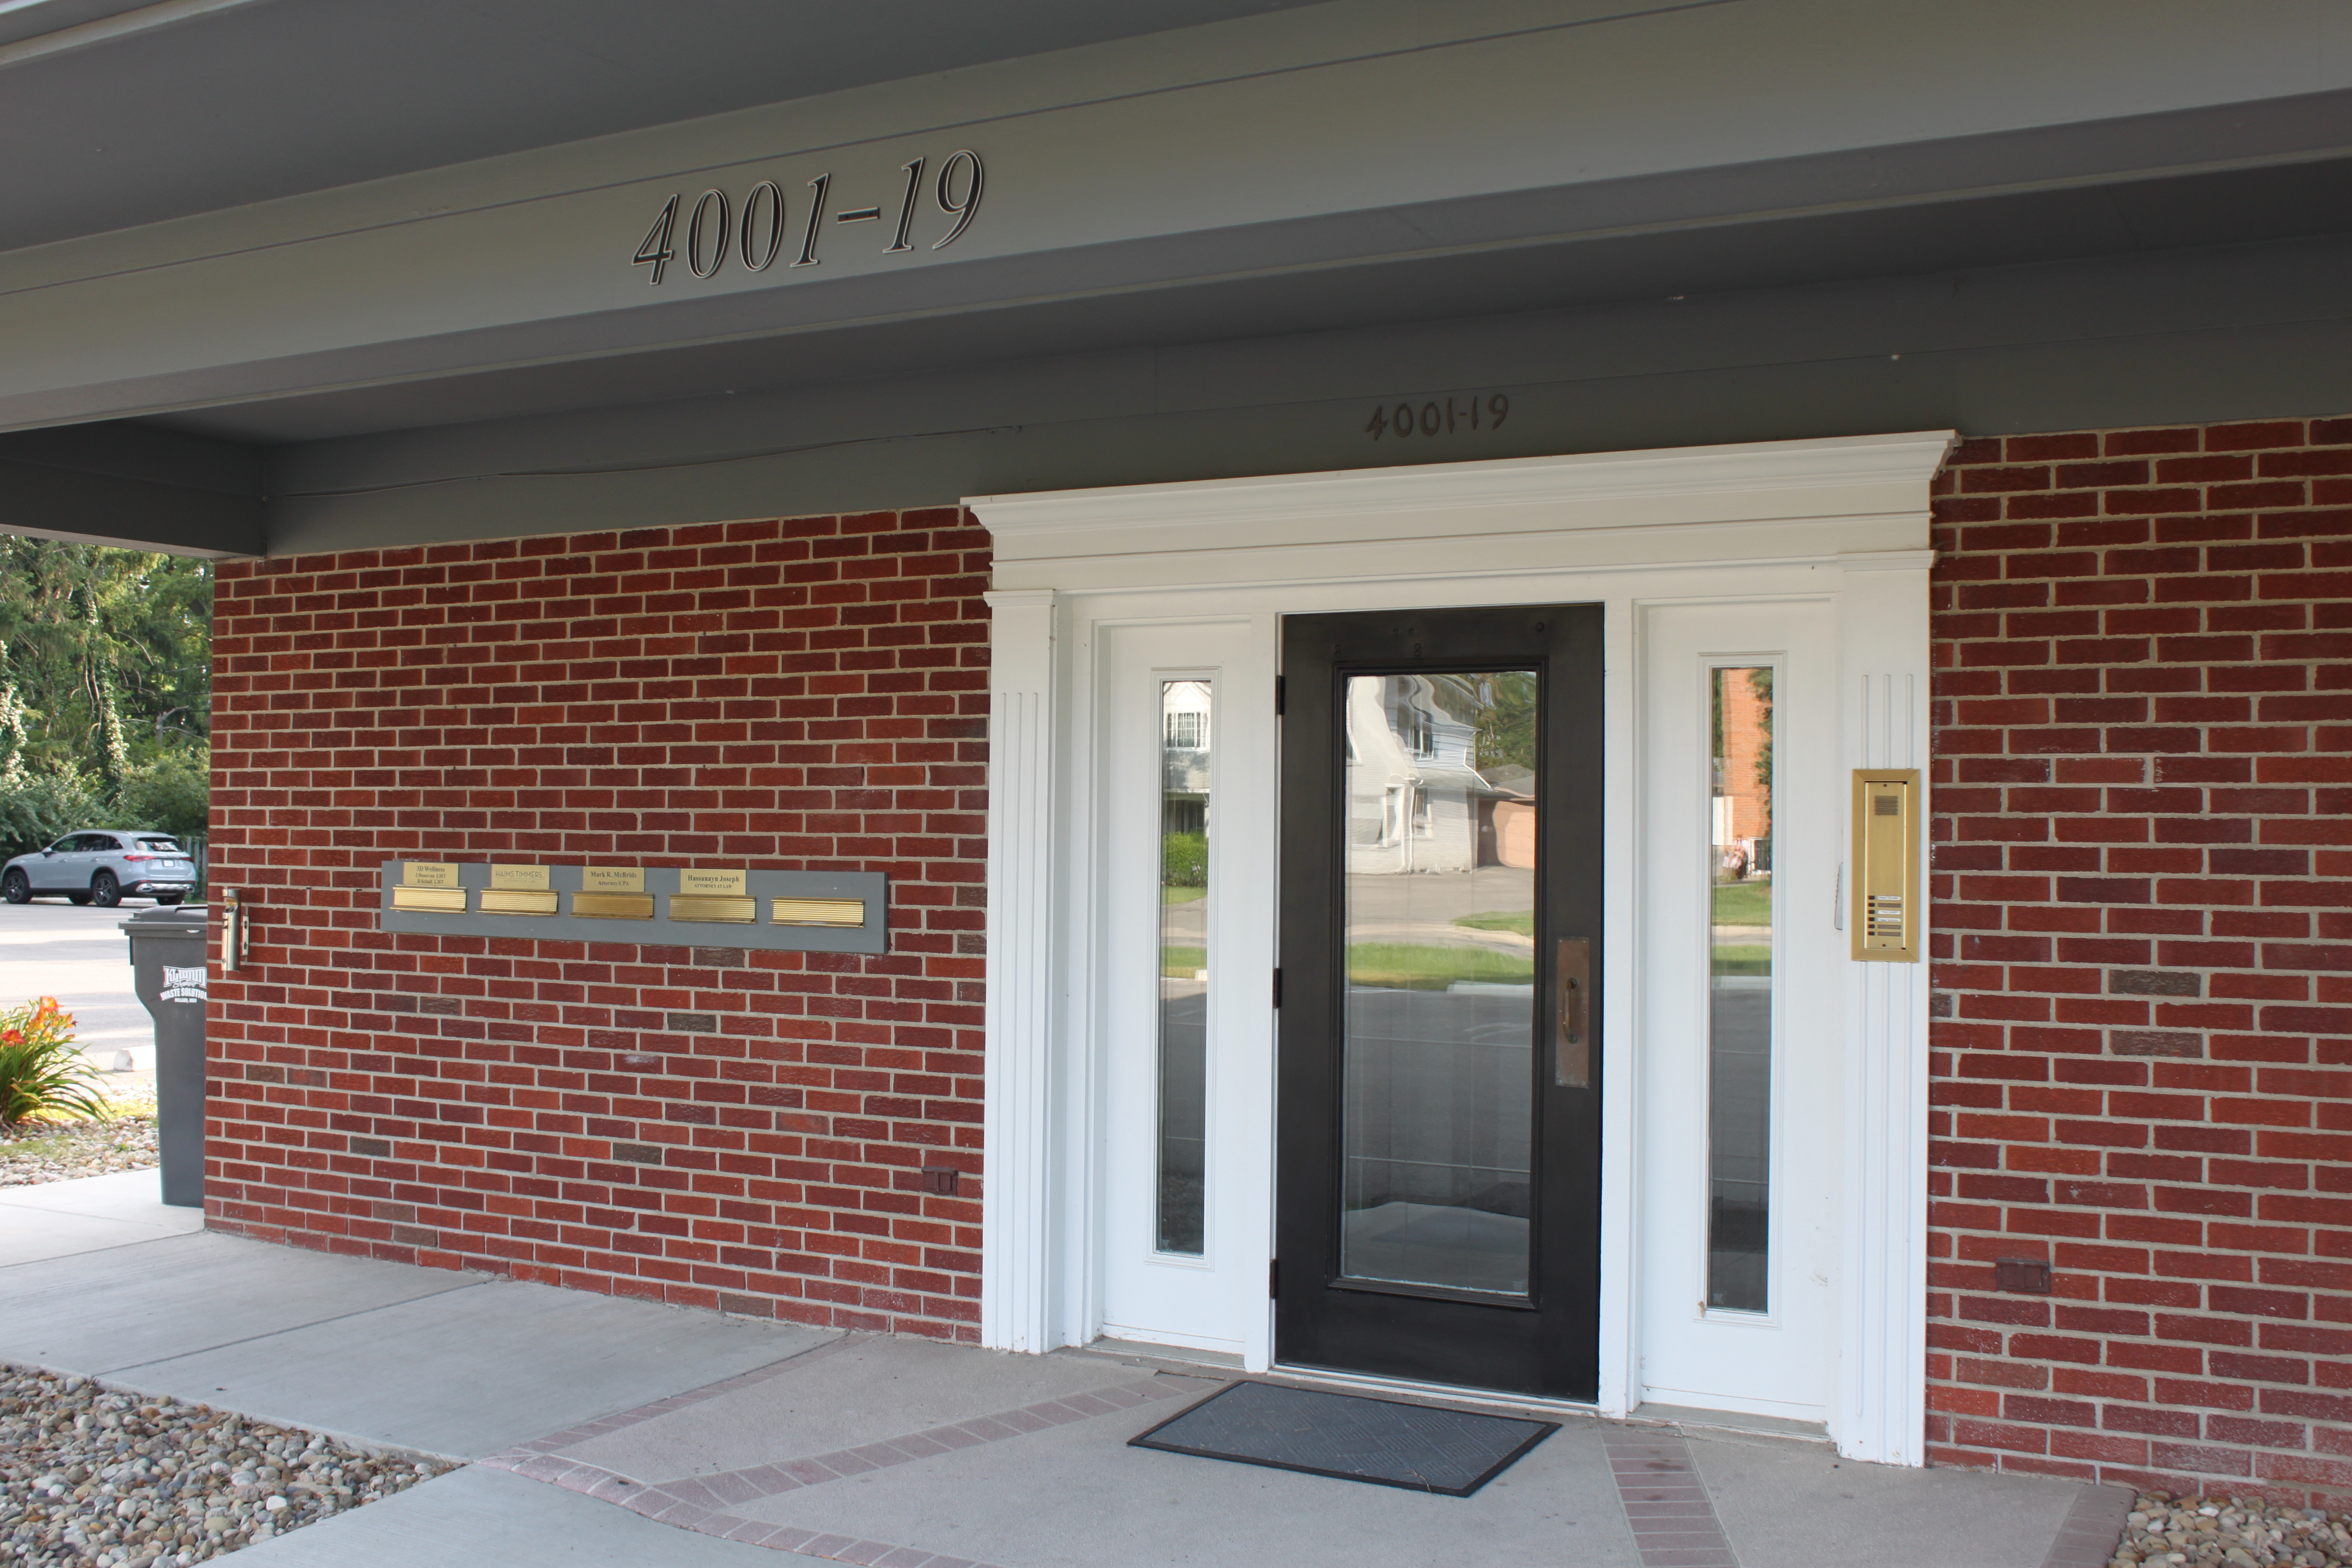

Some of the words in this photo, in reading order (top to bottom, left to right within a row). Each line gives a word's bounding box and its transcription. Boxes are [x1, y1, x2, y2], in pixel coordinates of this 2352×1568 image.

[632, 149, 984, 285] 4001-19
[1365, 393, 1509, 441] 4001-19
[687, 875, 718, 883] Hassanayn
[160, 988, 181, 1001] WASTE
